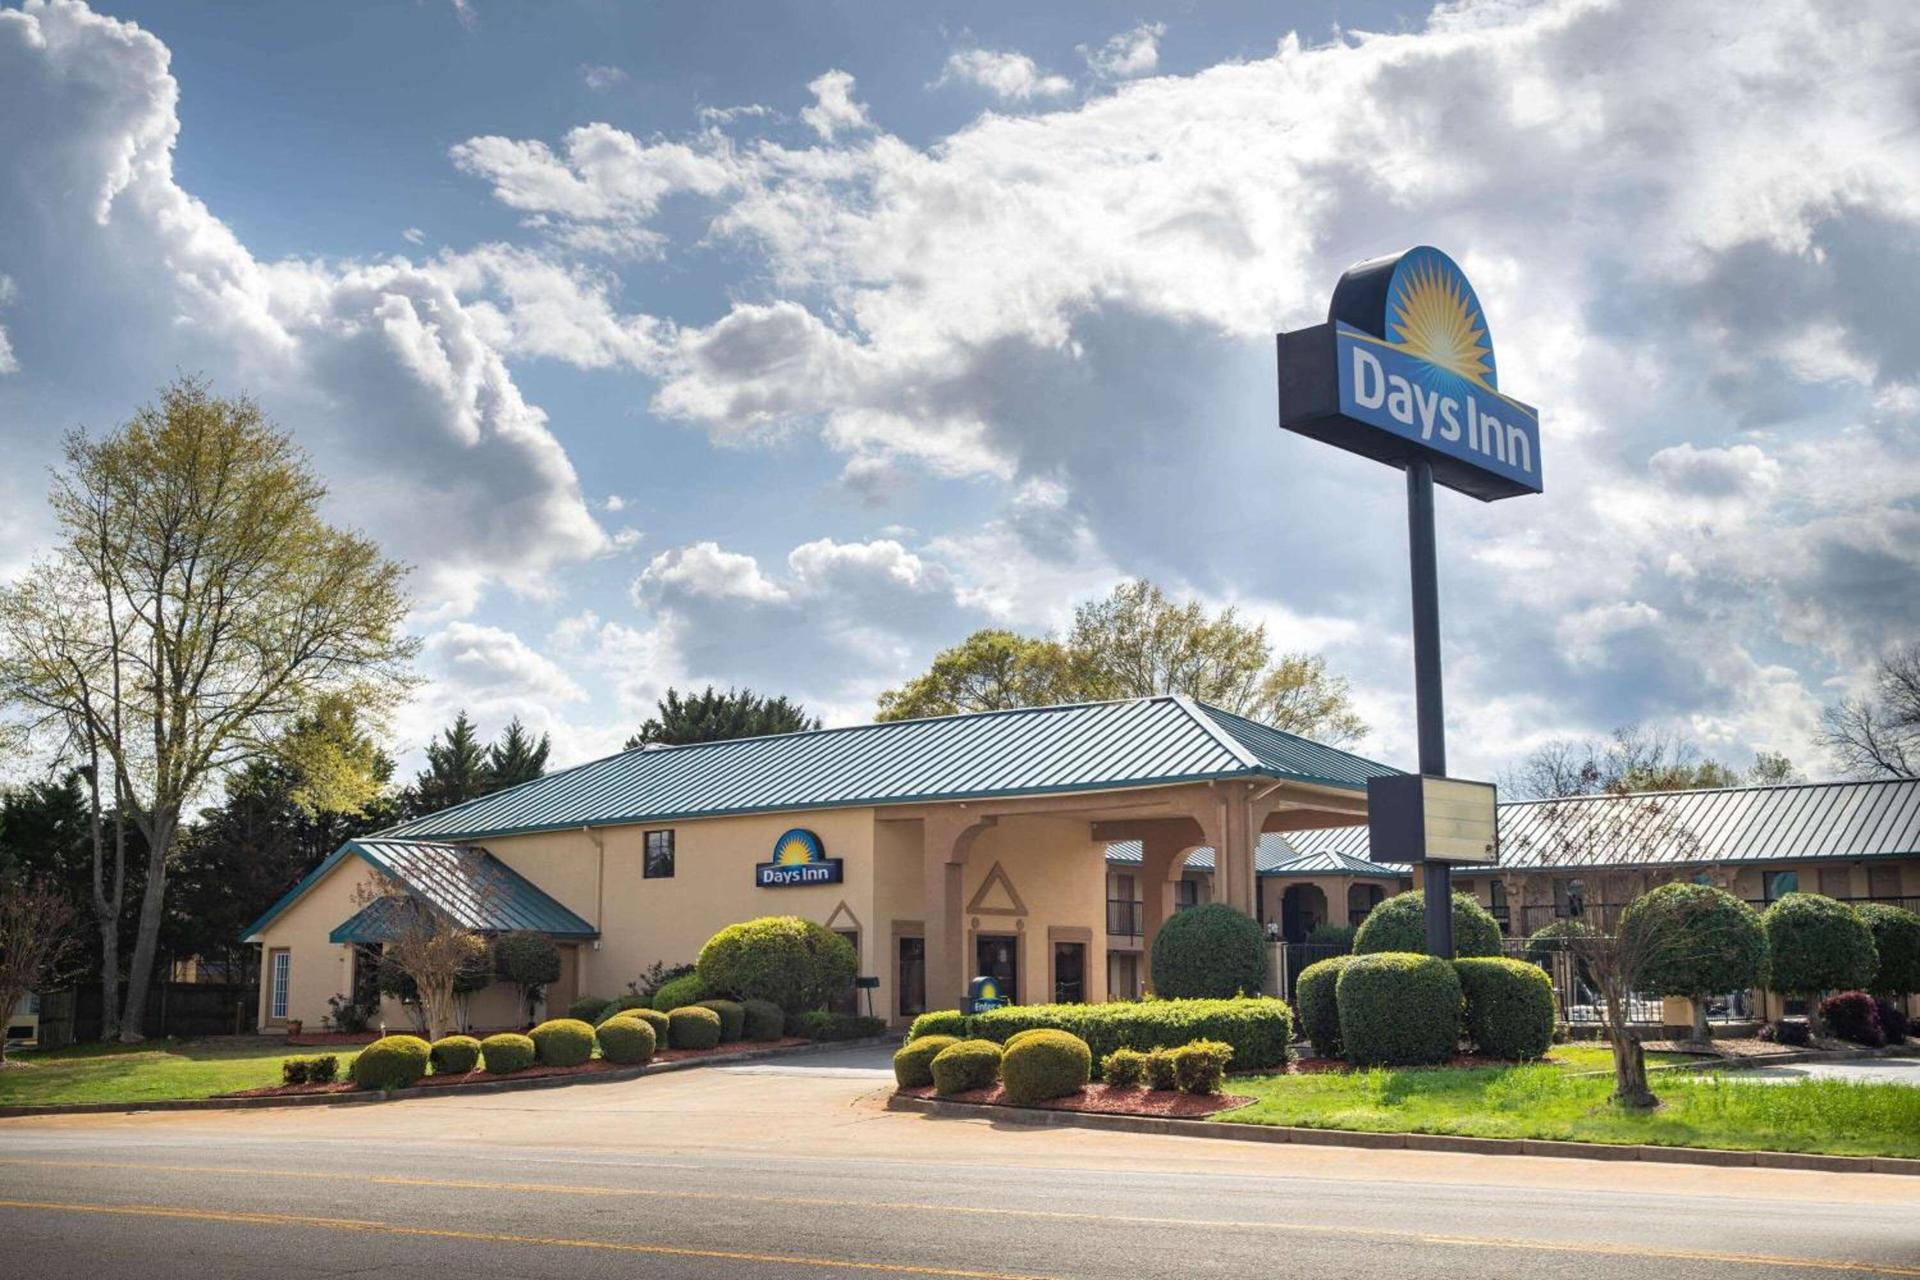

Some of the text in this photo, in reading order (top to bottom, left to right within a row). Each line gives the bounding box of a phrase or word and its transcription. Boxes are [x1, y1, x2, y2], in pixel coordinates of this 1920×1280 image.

[1353, 346, 1532, 473] Days Inn
[763, 867, 829, 884] Days Inn
